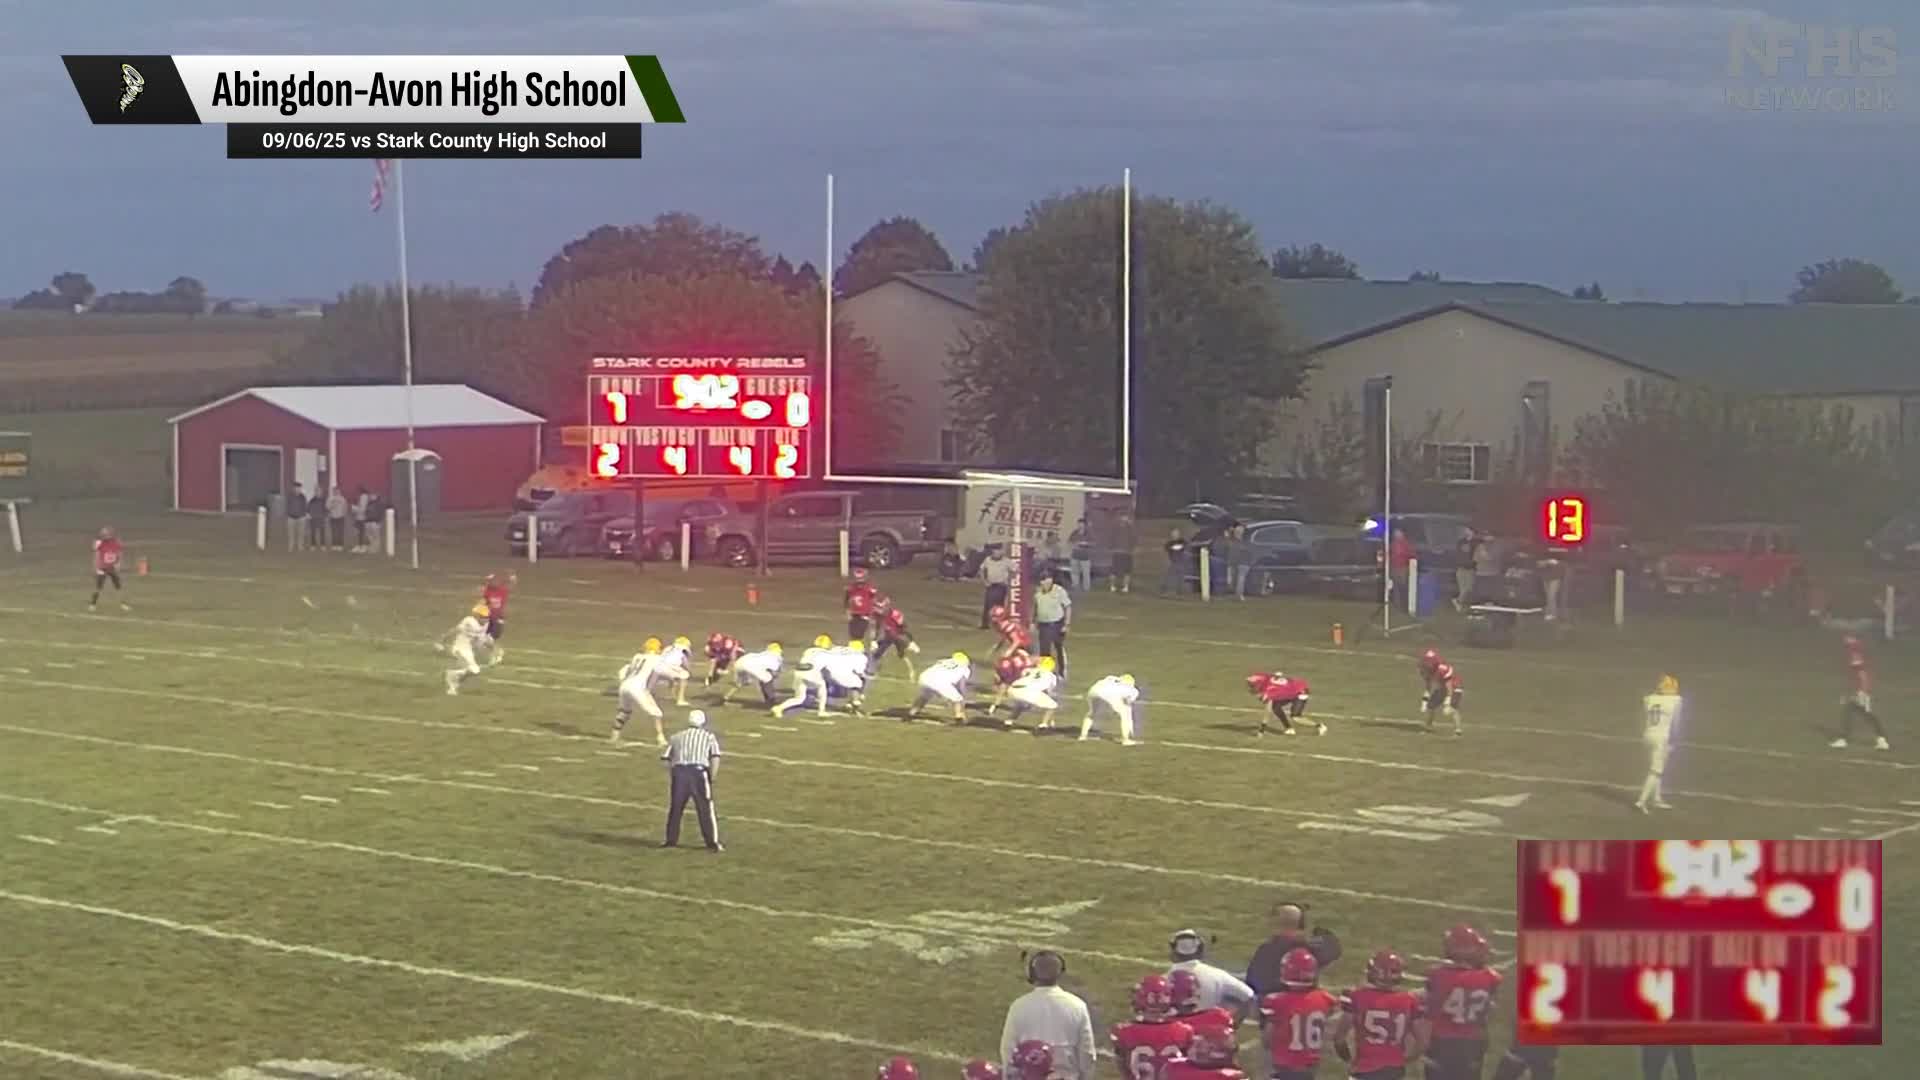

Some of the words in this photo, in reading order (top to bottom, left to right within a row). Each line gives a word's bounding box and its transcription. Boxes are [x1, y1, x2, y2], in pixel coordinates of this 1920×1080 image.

[592, 357, 652, 368] STARK
[656, 357, 733, 368] COUNTY
[736, 357, 806, 368] REBELS
[601, 377, 641, 396] HOME
[746, 377, 806, 396] GUESTS
[787, 392, 809, 427] 0
[597, 443, 619, 477] 2
[664, 446, 686, 475] 4
[729, 446, 751, 475] 4
[776, 445, 797, 478] 2
[1549, 499, 1583, 541] 13
[1839, 867, 1874, 932] 0
[1442, 987, 1489, 1024] 42
[1530, 963, 1567, 1025] 2
[1638, 967, 1674, 1022] 4
[1744, 967, 1780, 1022] 4
[1819, 965, 1855, 1028] 2
[1289, 1010, 1328, 1051] 16
[1364, 1009, 1407, 1046] 51
